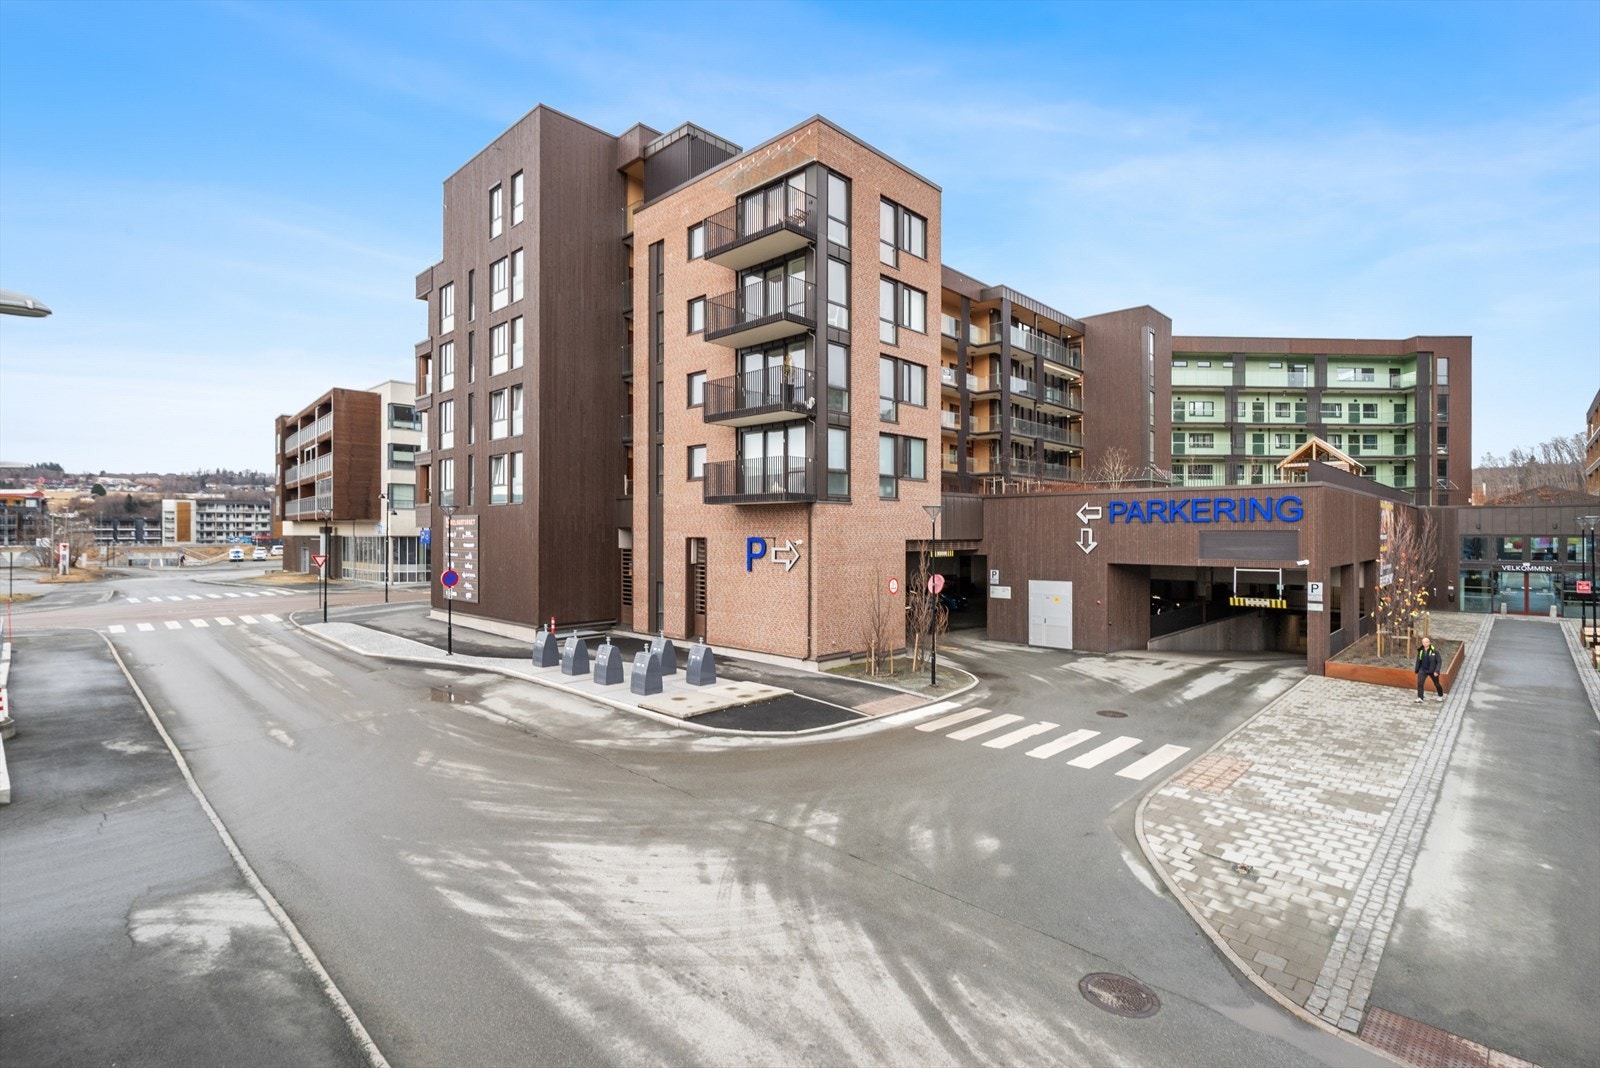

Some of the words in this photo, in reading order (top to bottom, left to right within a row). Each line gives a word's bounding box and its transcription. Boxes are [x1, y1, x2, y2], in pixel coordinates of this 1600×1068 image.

[1109, 495, 1304, 523] PARKERING
[746, 537, 767, 572] P
[992, 570, 998, 578] P
[1311, 583, 1320, 593] P
